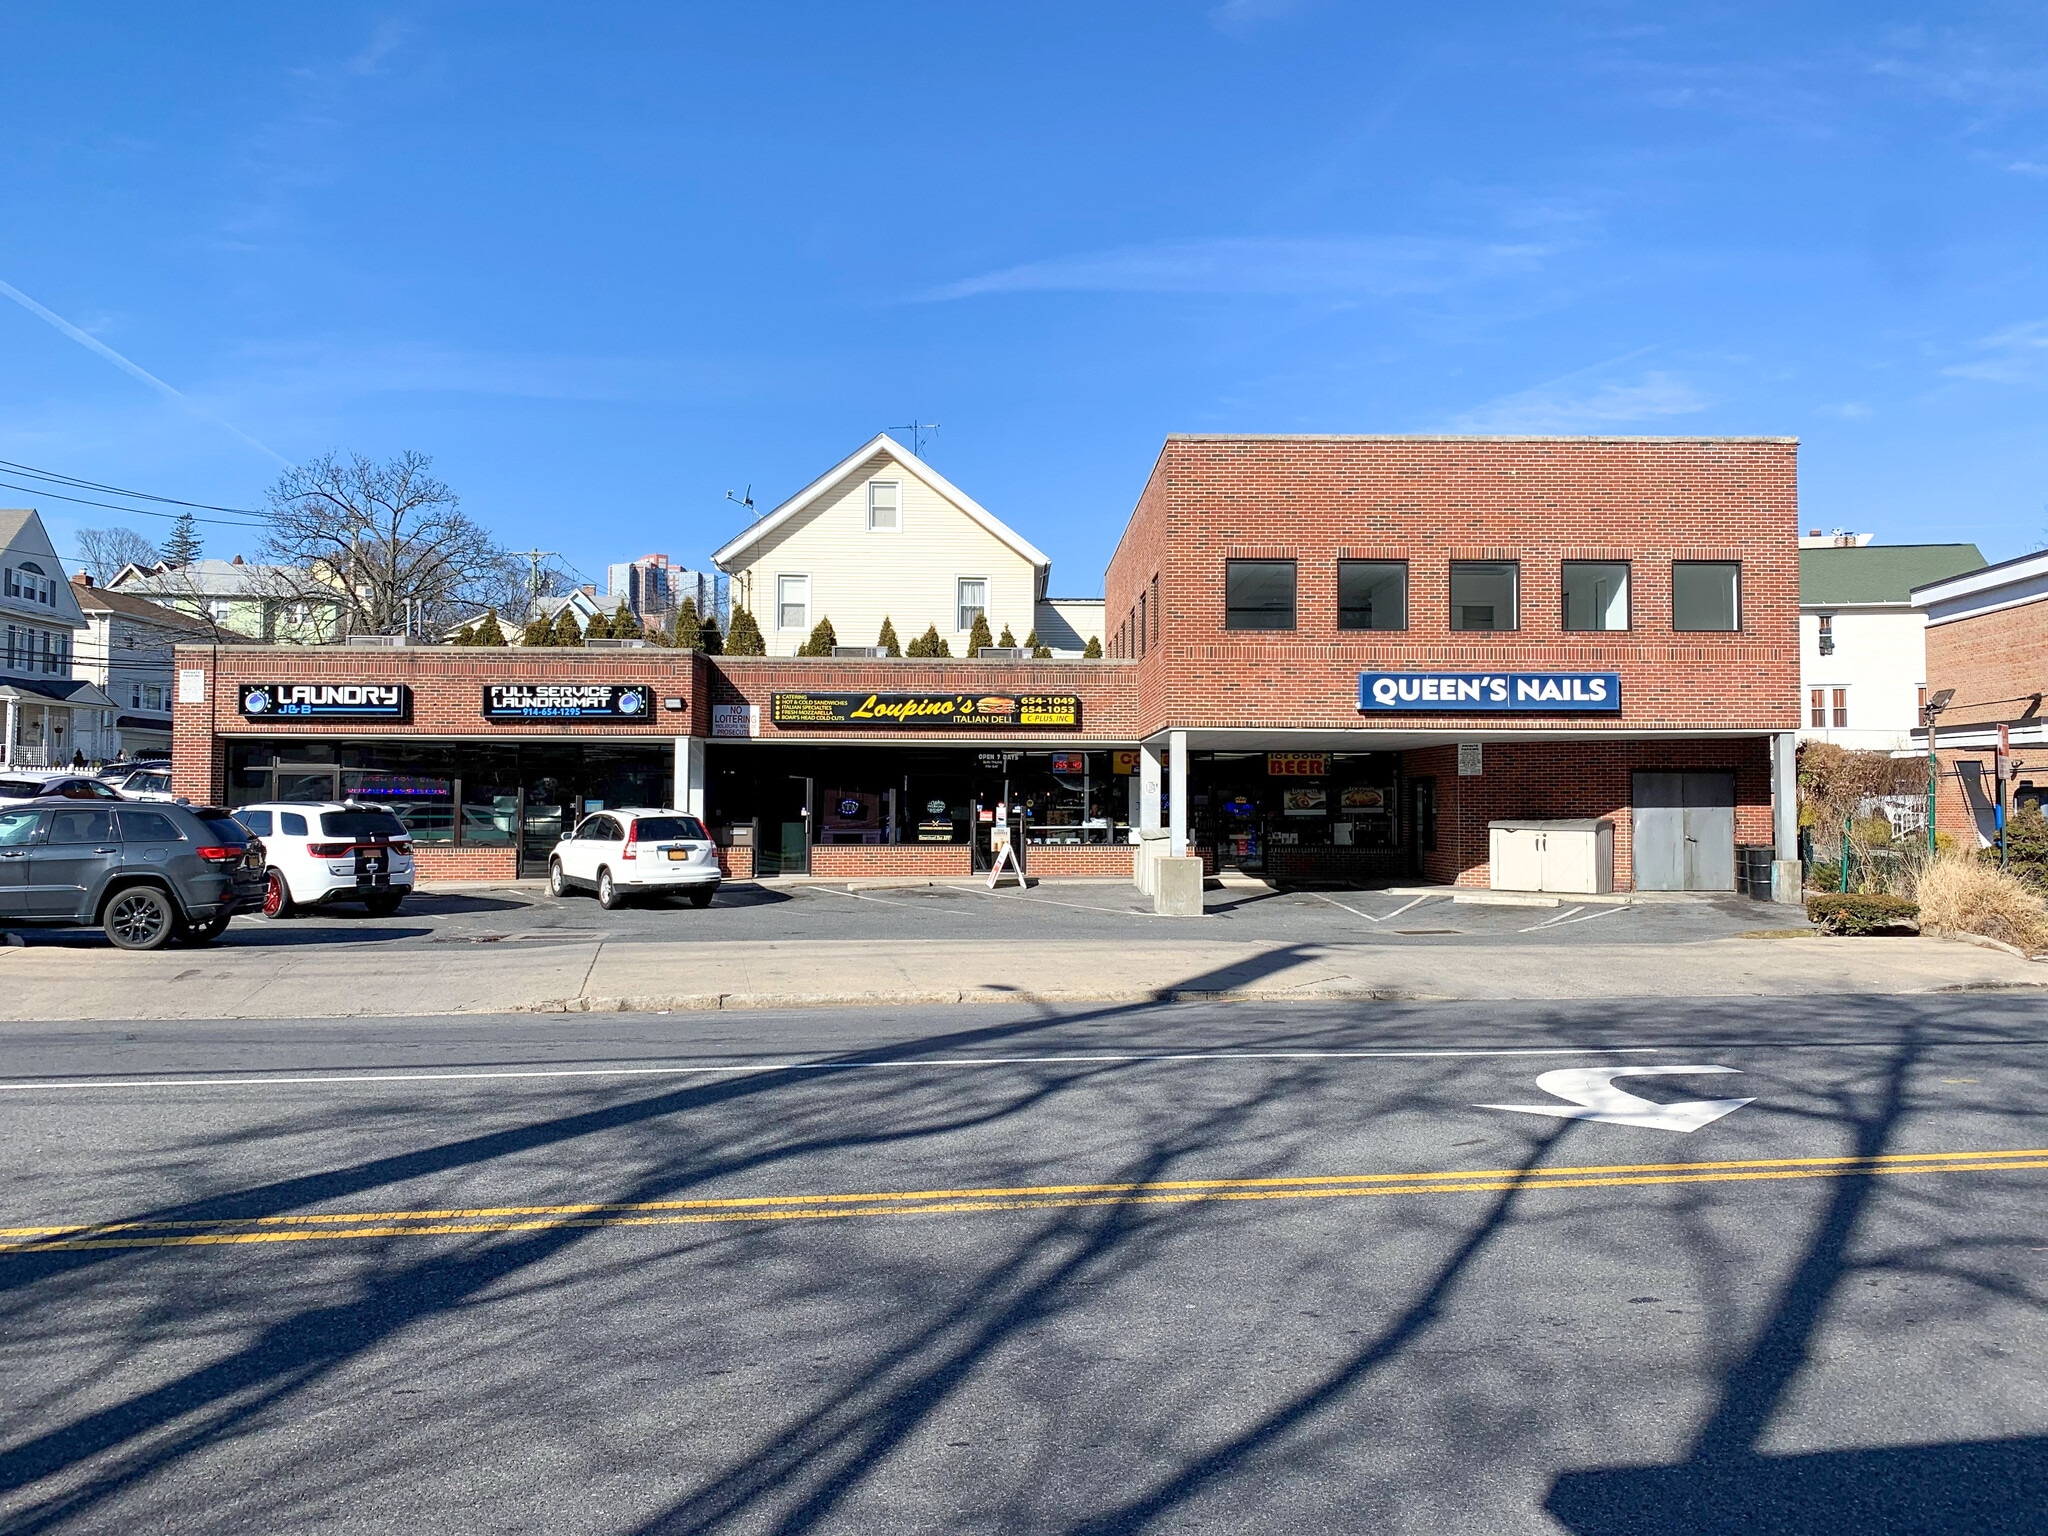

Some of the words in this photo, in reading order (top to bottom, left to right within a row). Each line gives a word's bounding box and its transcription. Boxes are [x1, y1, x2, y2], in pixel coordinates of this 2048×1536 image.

[278, 686, 398, 705] LAUNDRY
[491, 686, 533, 697] FULL
[536, 686, 612, 697] SERVICE
[1372, 677, 1507, 706] QUEEN'S
[1517, 678, 1607, 701] NAILS
[493, 697, 610, 708] LAUNDROMAT
[1020, 697, 1075, 705] 654-1049
[278, 705, 312, 714] J&B
[523, 708, 581, 716] 914-654-1295
[730, 706, 743, 714] NO
[850, 694, 975, 722] Loupino's
[1020, 705, 1075, 713] 654-1053
[714, 715, 757, 723] LOITERING
[953, 715, 989, 723] ITALIAN
[991, 715, 1012, 723] DELI
[1270, 760, 1323, 774] BEER
